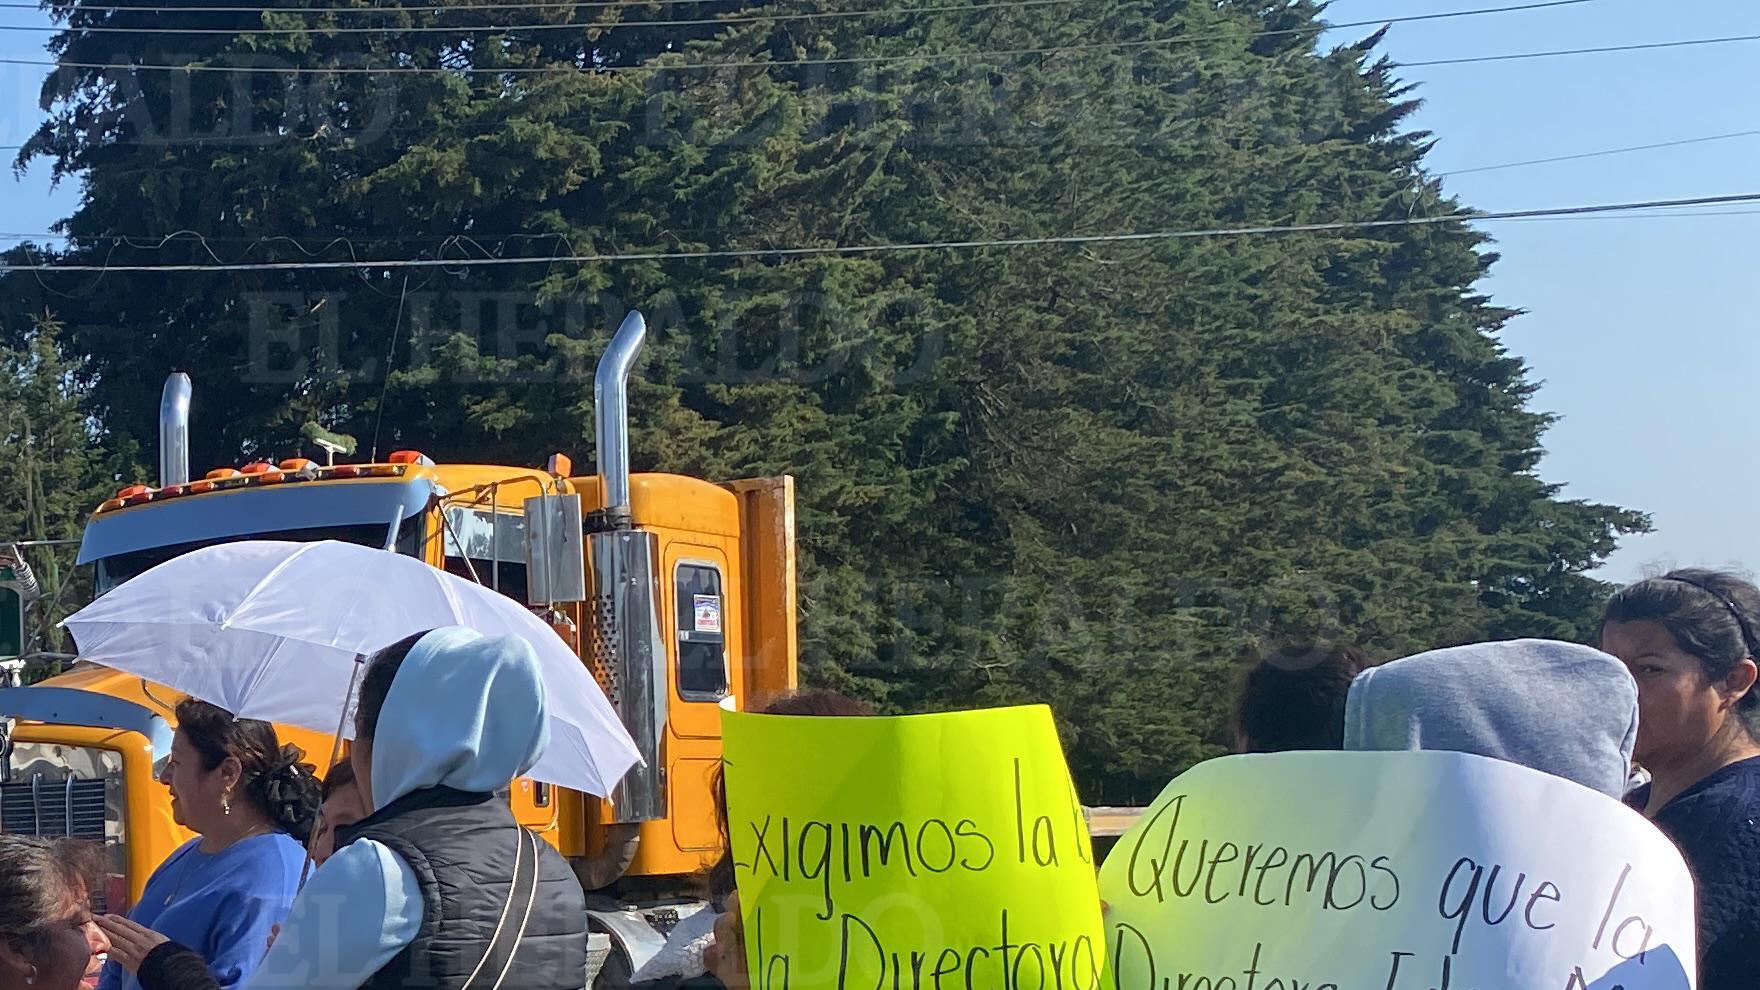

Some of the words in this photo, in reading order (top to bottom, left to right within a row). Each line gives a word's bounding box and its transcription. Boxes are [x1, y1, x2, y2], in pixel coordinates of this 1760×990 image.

[734, 812, 994, 921] xigimos
[1014, 757, 1058, 869] la
[1128, 795, 1400, 911] Queremos
[1439, 857, 1562, 954] que
[1592, 862, 1654, 966] la
